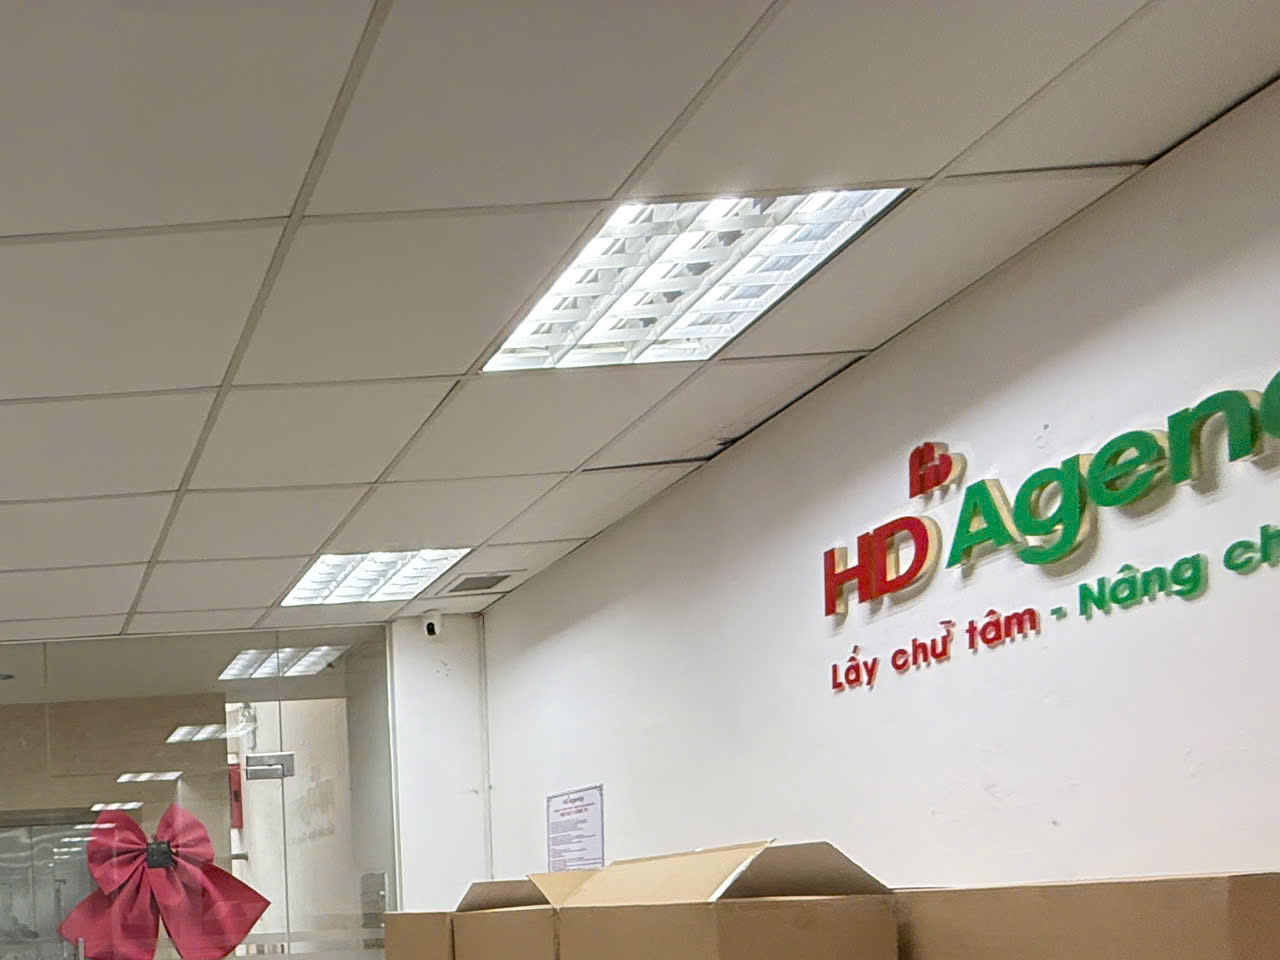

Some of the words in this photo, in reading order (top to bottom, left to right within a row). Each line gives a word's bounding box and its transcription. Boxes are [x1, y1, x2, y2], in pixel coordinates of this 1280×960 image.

[832, 646, 877, 690] Lấy
[966, 609, 1038, 650] tâm
[1079, 553, 1206, 616] Nâng
